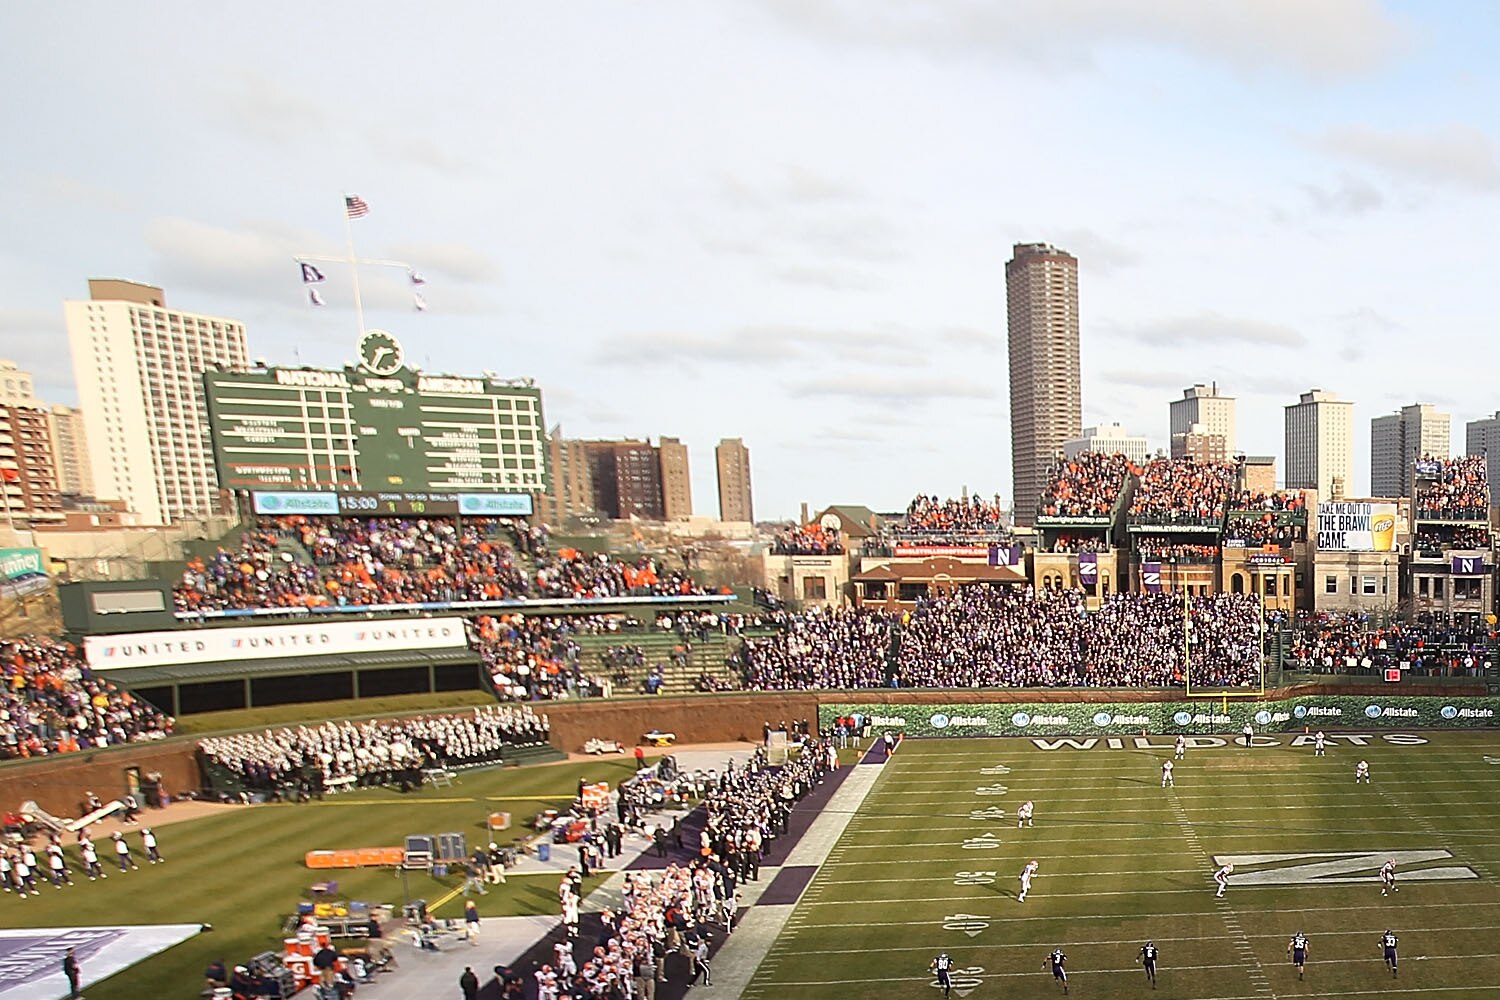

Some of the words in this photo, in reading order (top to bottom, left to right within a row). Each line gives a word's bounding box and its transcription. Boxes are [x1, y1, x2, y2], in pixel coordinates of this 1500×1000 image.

[275, 370, 351, 388] NATIONAL
[417, 376, 484, 394] AMERICAN
[284, 496, 331, 509] Allstate
[339, 497, 377, 509] 15:00
[410, 502, 426, 513] 10
[1318, 503, 1335, 515] TAKE
[1336, 503, 1347, 515] ME
[1347, 503, 1361, 515] OUT
[1362, 503, 1371, 515] TO
[1318, 515, 1337, 531] THE
[1339, 514, 1371, 532] BRAWL
[1318, 532, 1350, 549] GAME.
[998, 549, 1010, 565] N
[1461, 560, 1474, 573] N
[372, 627, 451, 641] UNITED
[249, 633, 331, 648] UNITED
[122, 641, 206, 657] UNITED
[1306, 706, 1342, 716] Allstate
[1381, 707, 1418, 717] Allstate
[1456, 708, 1494, 718] Allstate
[867, 715, 905, 726] llstate
[949, 715, 987, 726] Allstate
[1030, 715, 1068, 726] Allstate
[1111, 714, 1150, 725] Allstate
[1191, 713, 1231, 724] Allstate
[1033, 734, 1429, 751] WILDCATS
[1294, 938, 1304, 949] 35
[938, 958, 948, 969] 80
[1054, 953, 1061, 963] 3
